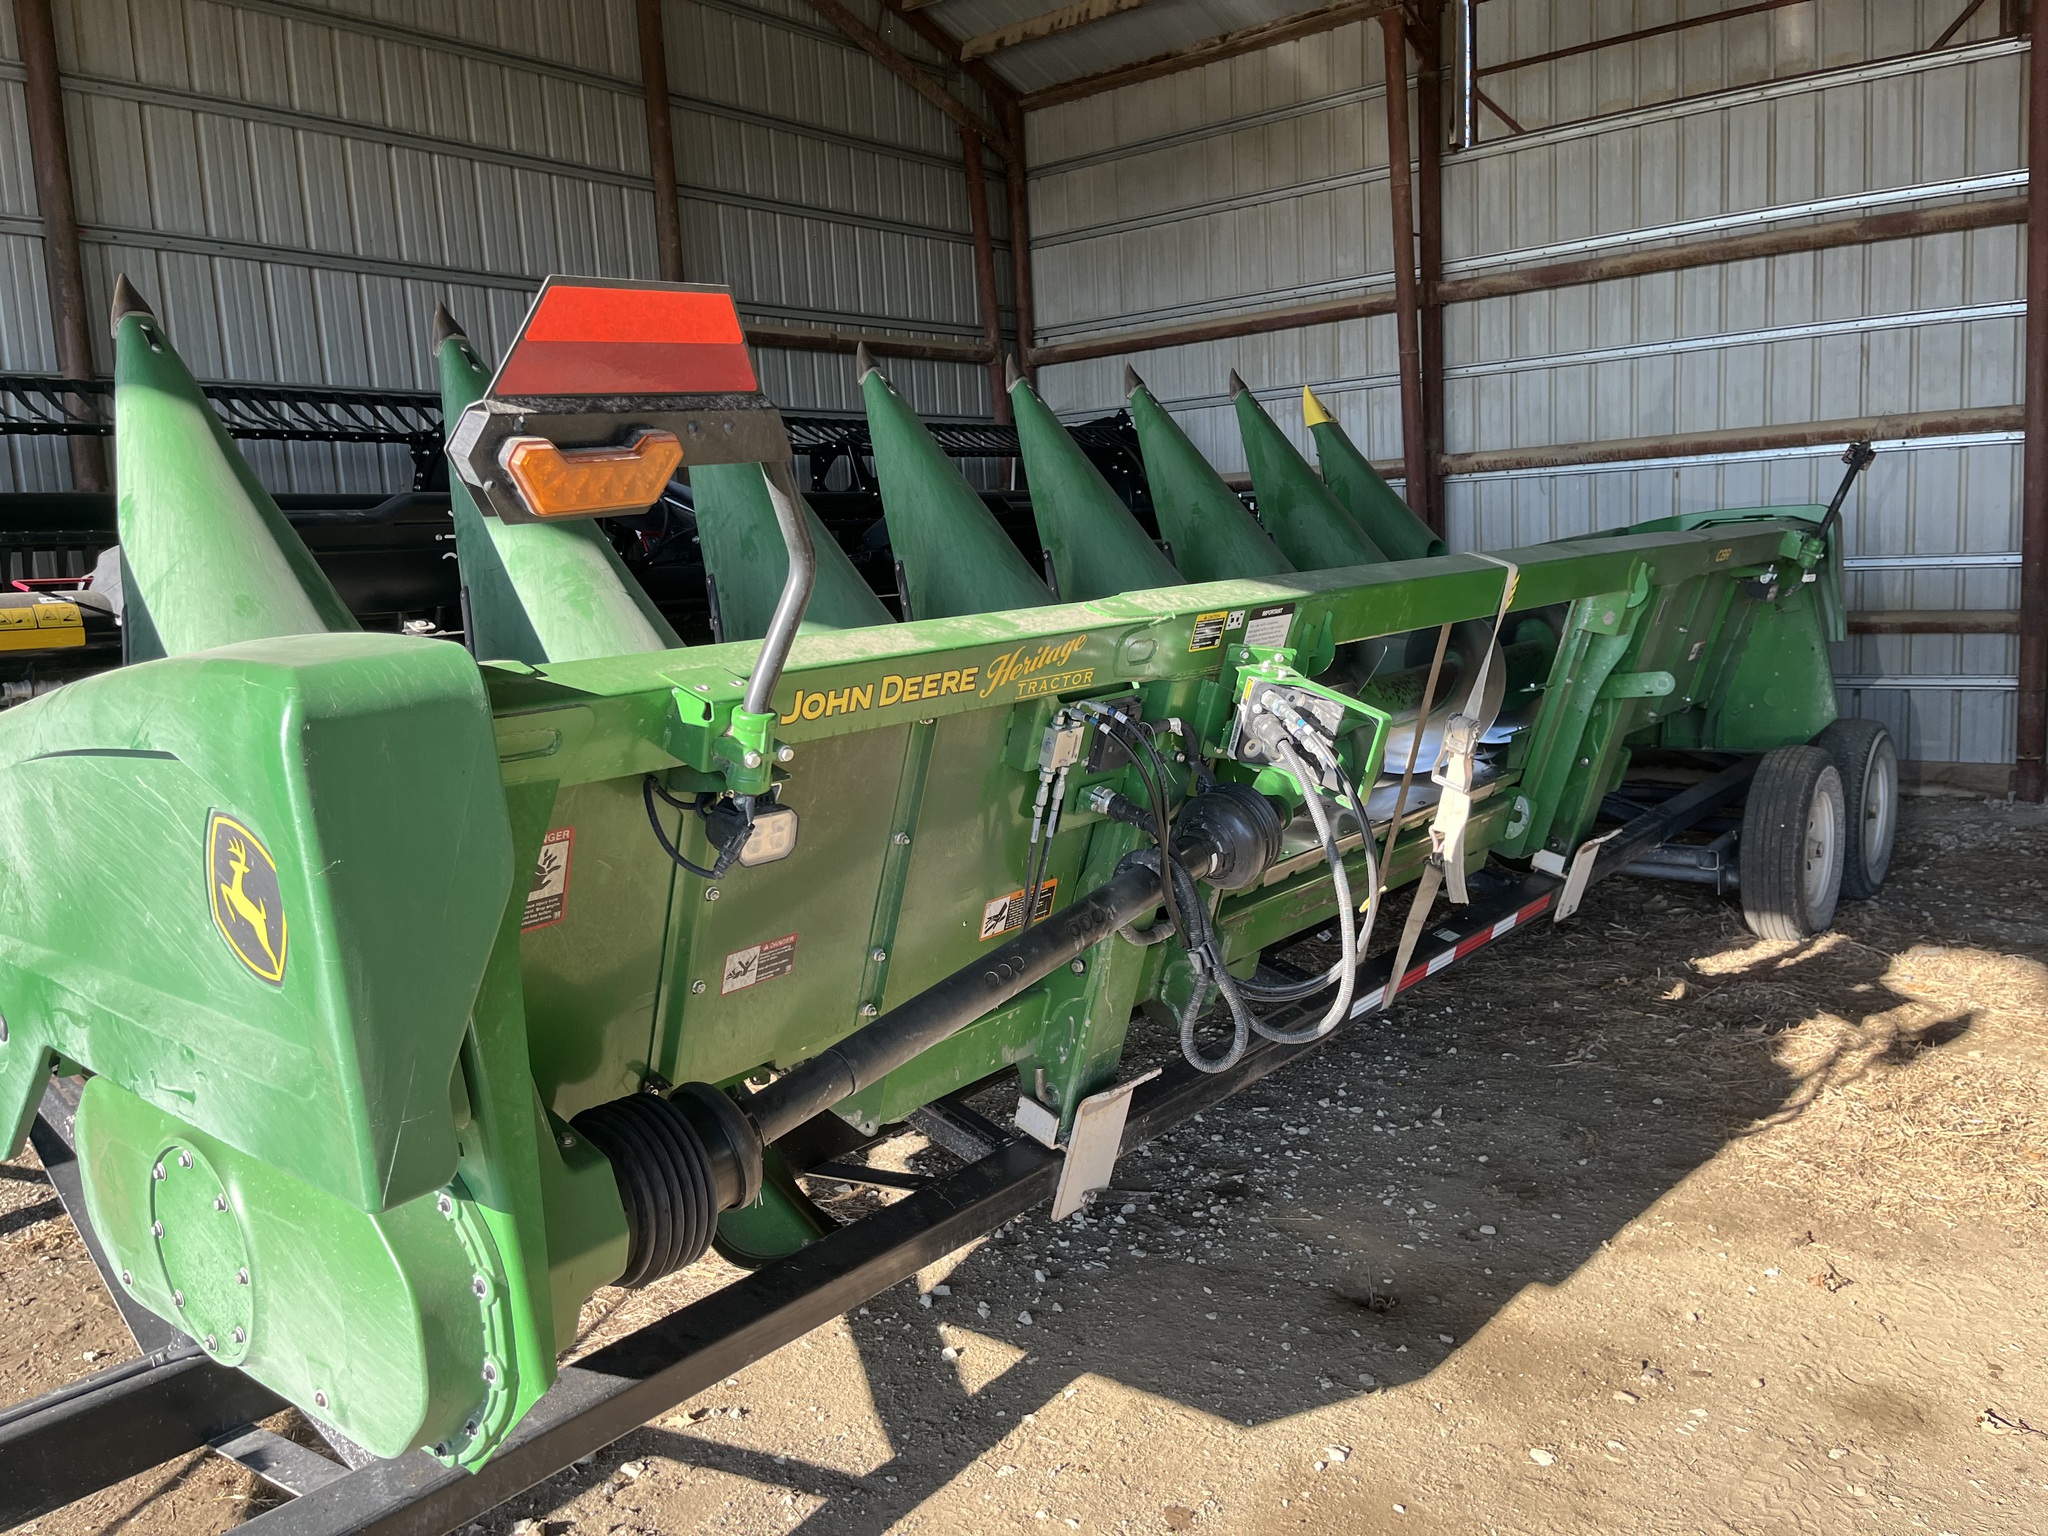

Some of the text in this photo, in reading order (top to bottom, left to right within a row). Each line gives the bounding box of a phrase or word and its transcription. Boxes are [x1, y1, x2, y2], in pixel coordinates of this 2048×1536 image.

[1262, 607, 1283, 616] IMPORTANT
[979, 634, 1088, 699] Heritage
[1018, 671, 1093, 695] TRACTOR
[780, 665, 980, 725] JOHN DEERE
